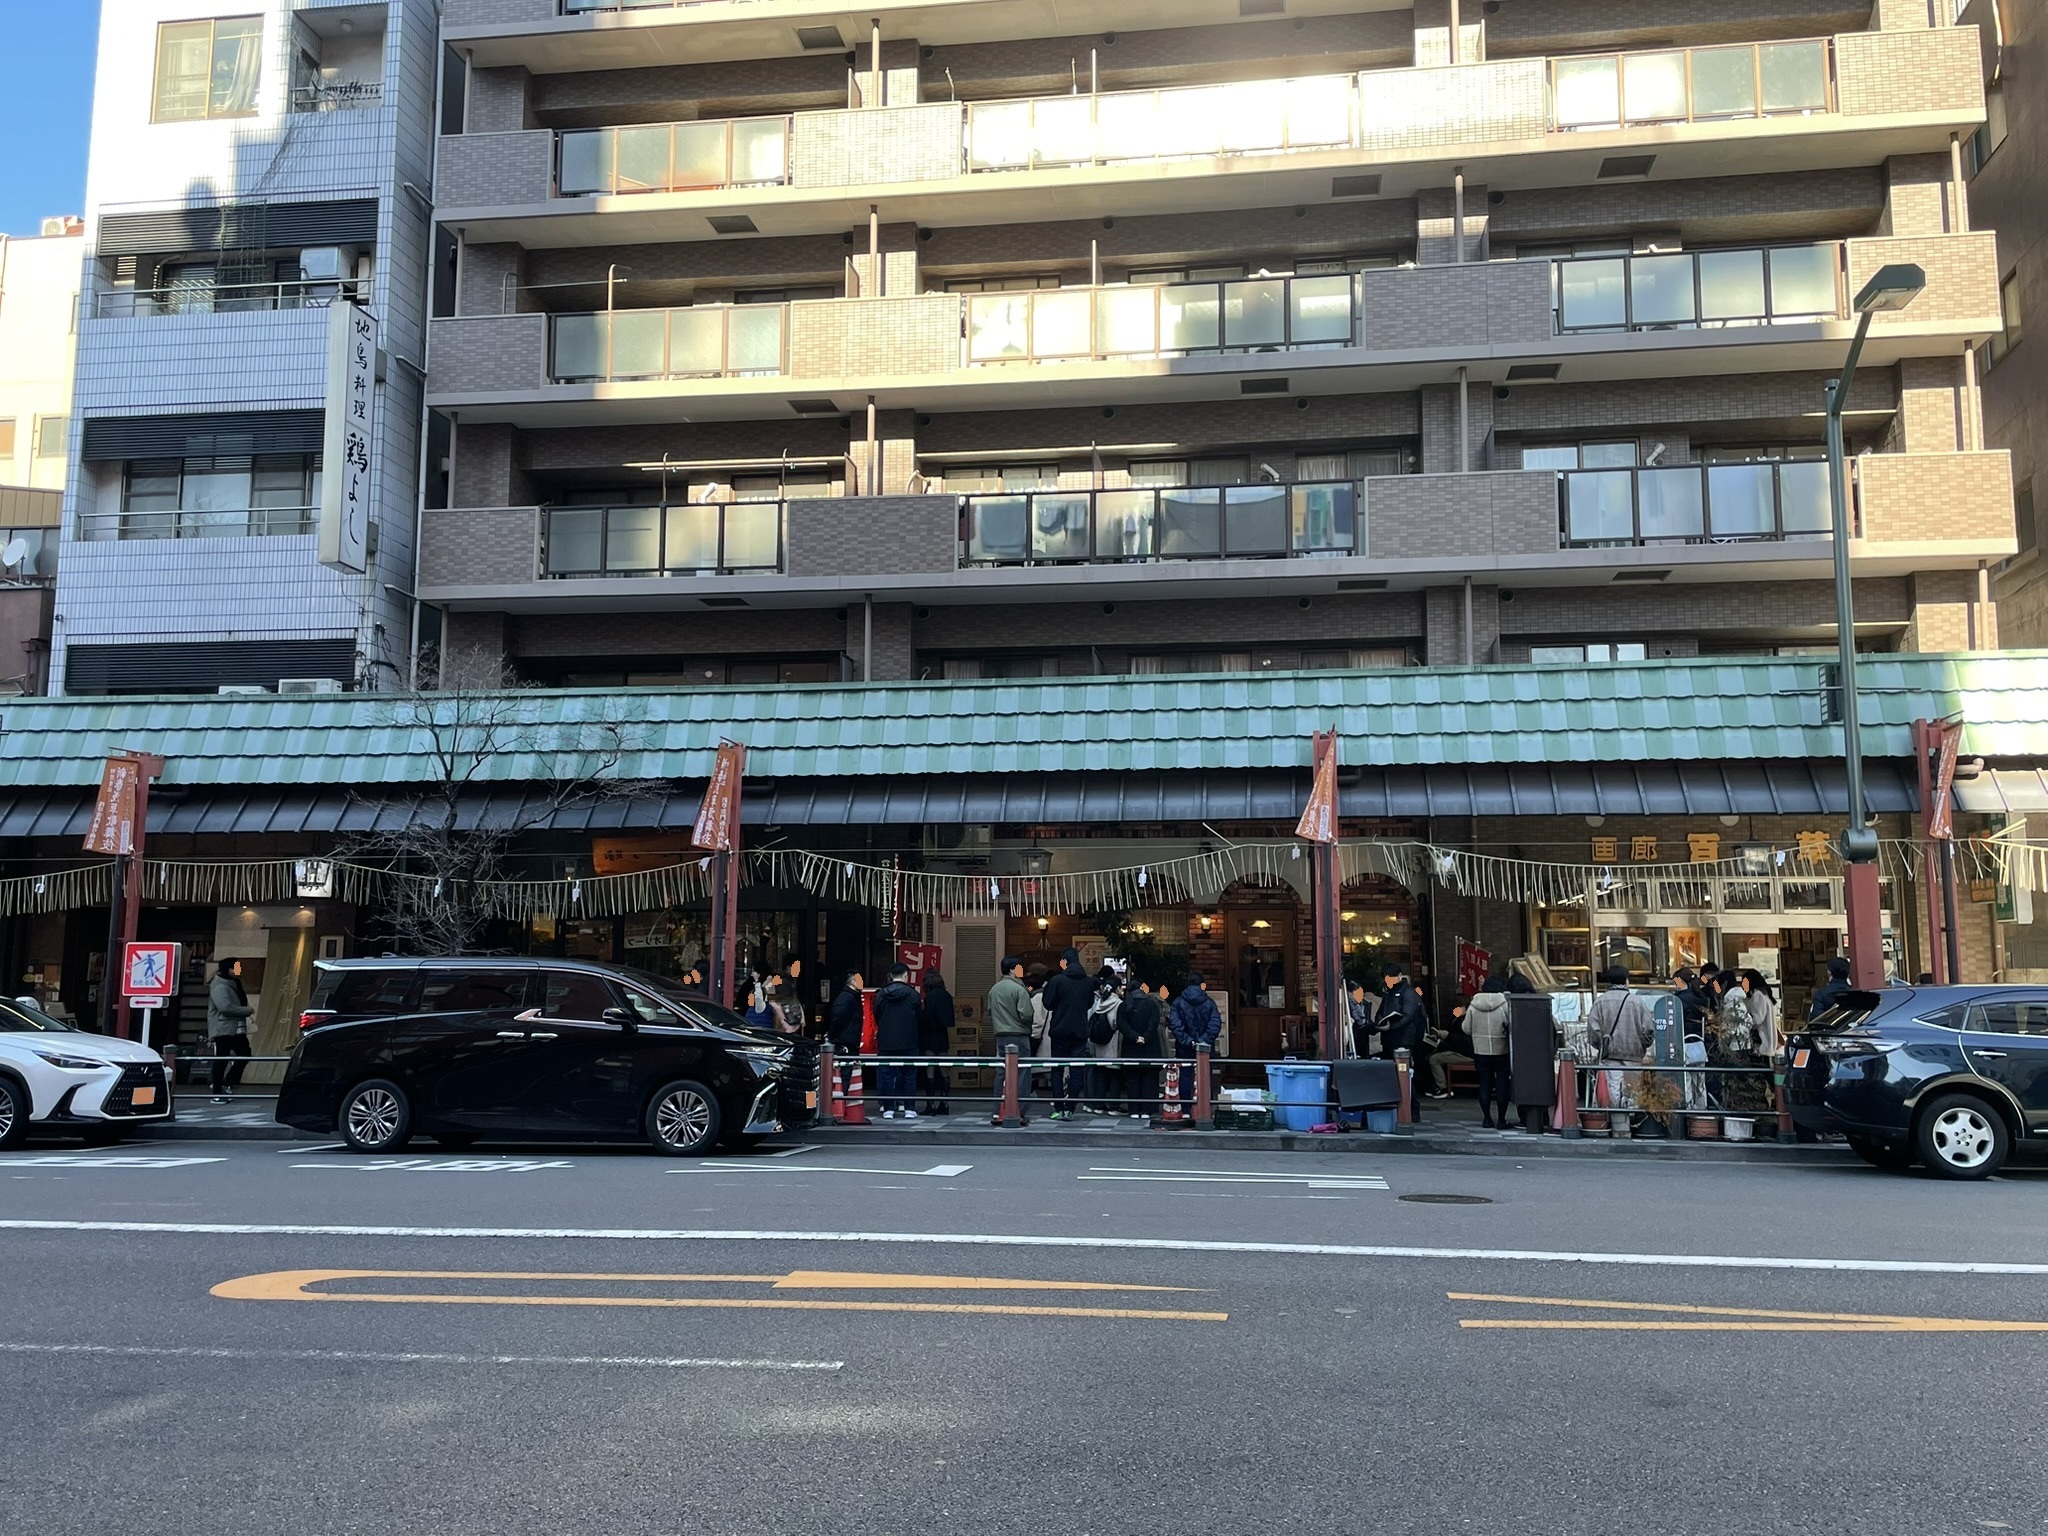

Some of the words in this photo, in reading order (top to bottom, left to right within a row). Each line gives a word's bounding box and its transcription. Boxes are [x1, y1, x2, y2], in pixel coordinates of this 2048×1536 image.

[353, 318, 371, 420] 地鳥料理
[346, 432, 368, 545] 鶏よし
[1591, 835, 1658, 862] 画廊
